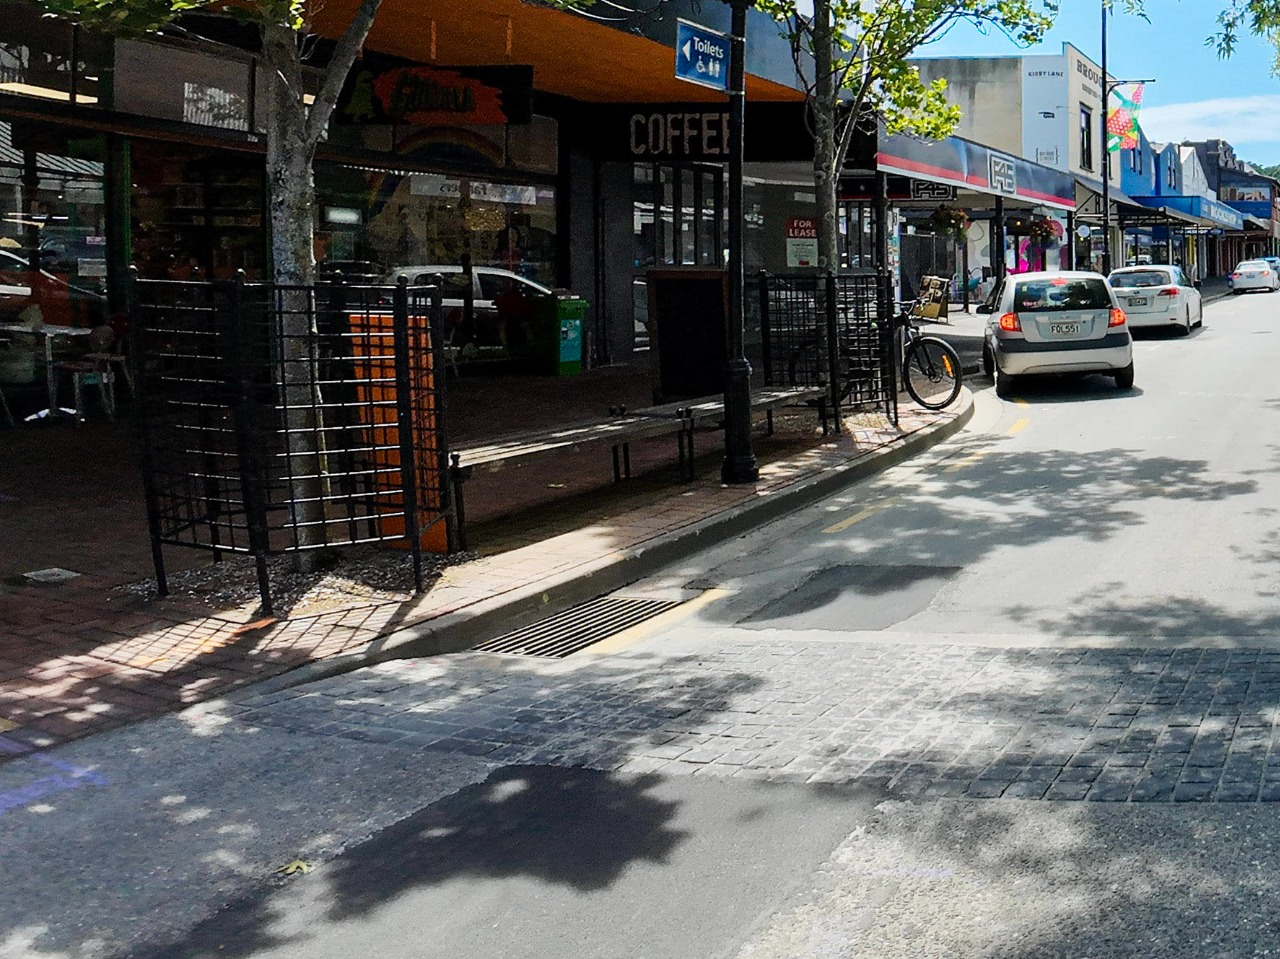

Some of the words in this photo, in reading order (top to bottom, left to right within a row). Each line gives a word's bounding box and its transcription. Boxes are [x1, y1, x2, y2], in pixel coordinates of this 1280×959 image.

[693, 36, 724, 59] Toilets
[990, 154, 1015, 194] F45
[914, 181, 951, 198] F45
[793, 220, 812, 228] FOR
[789, 229, 817, 237] LEASE
